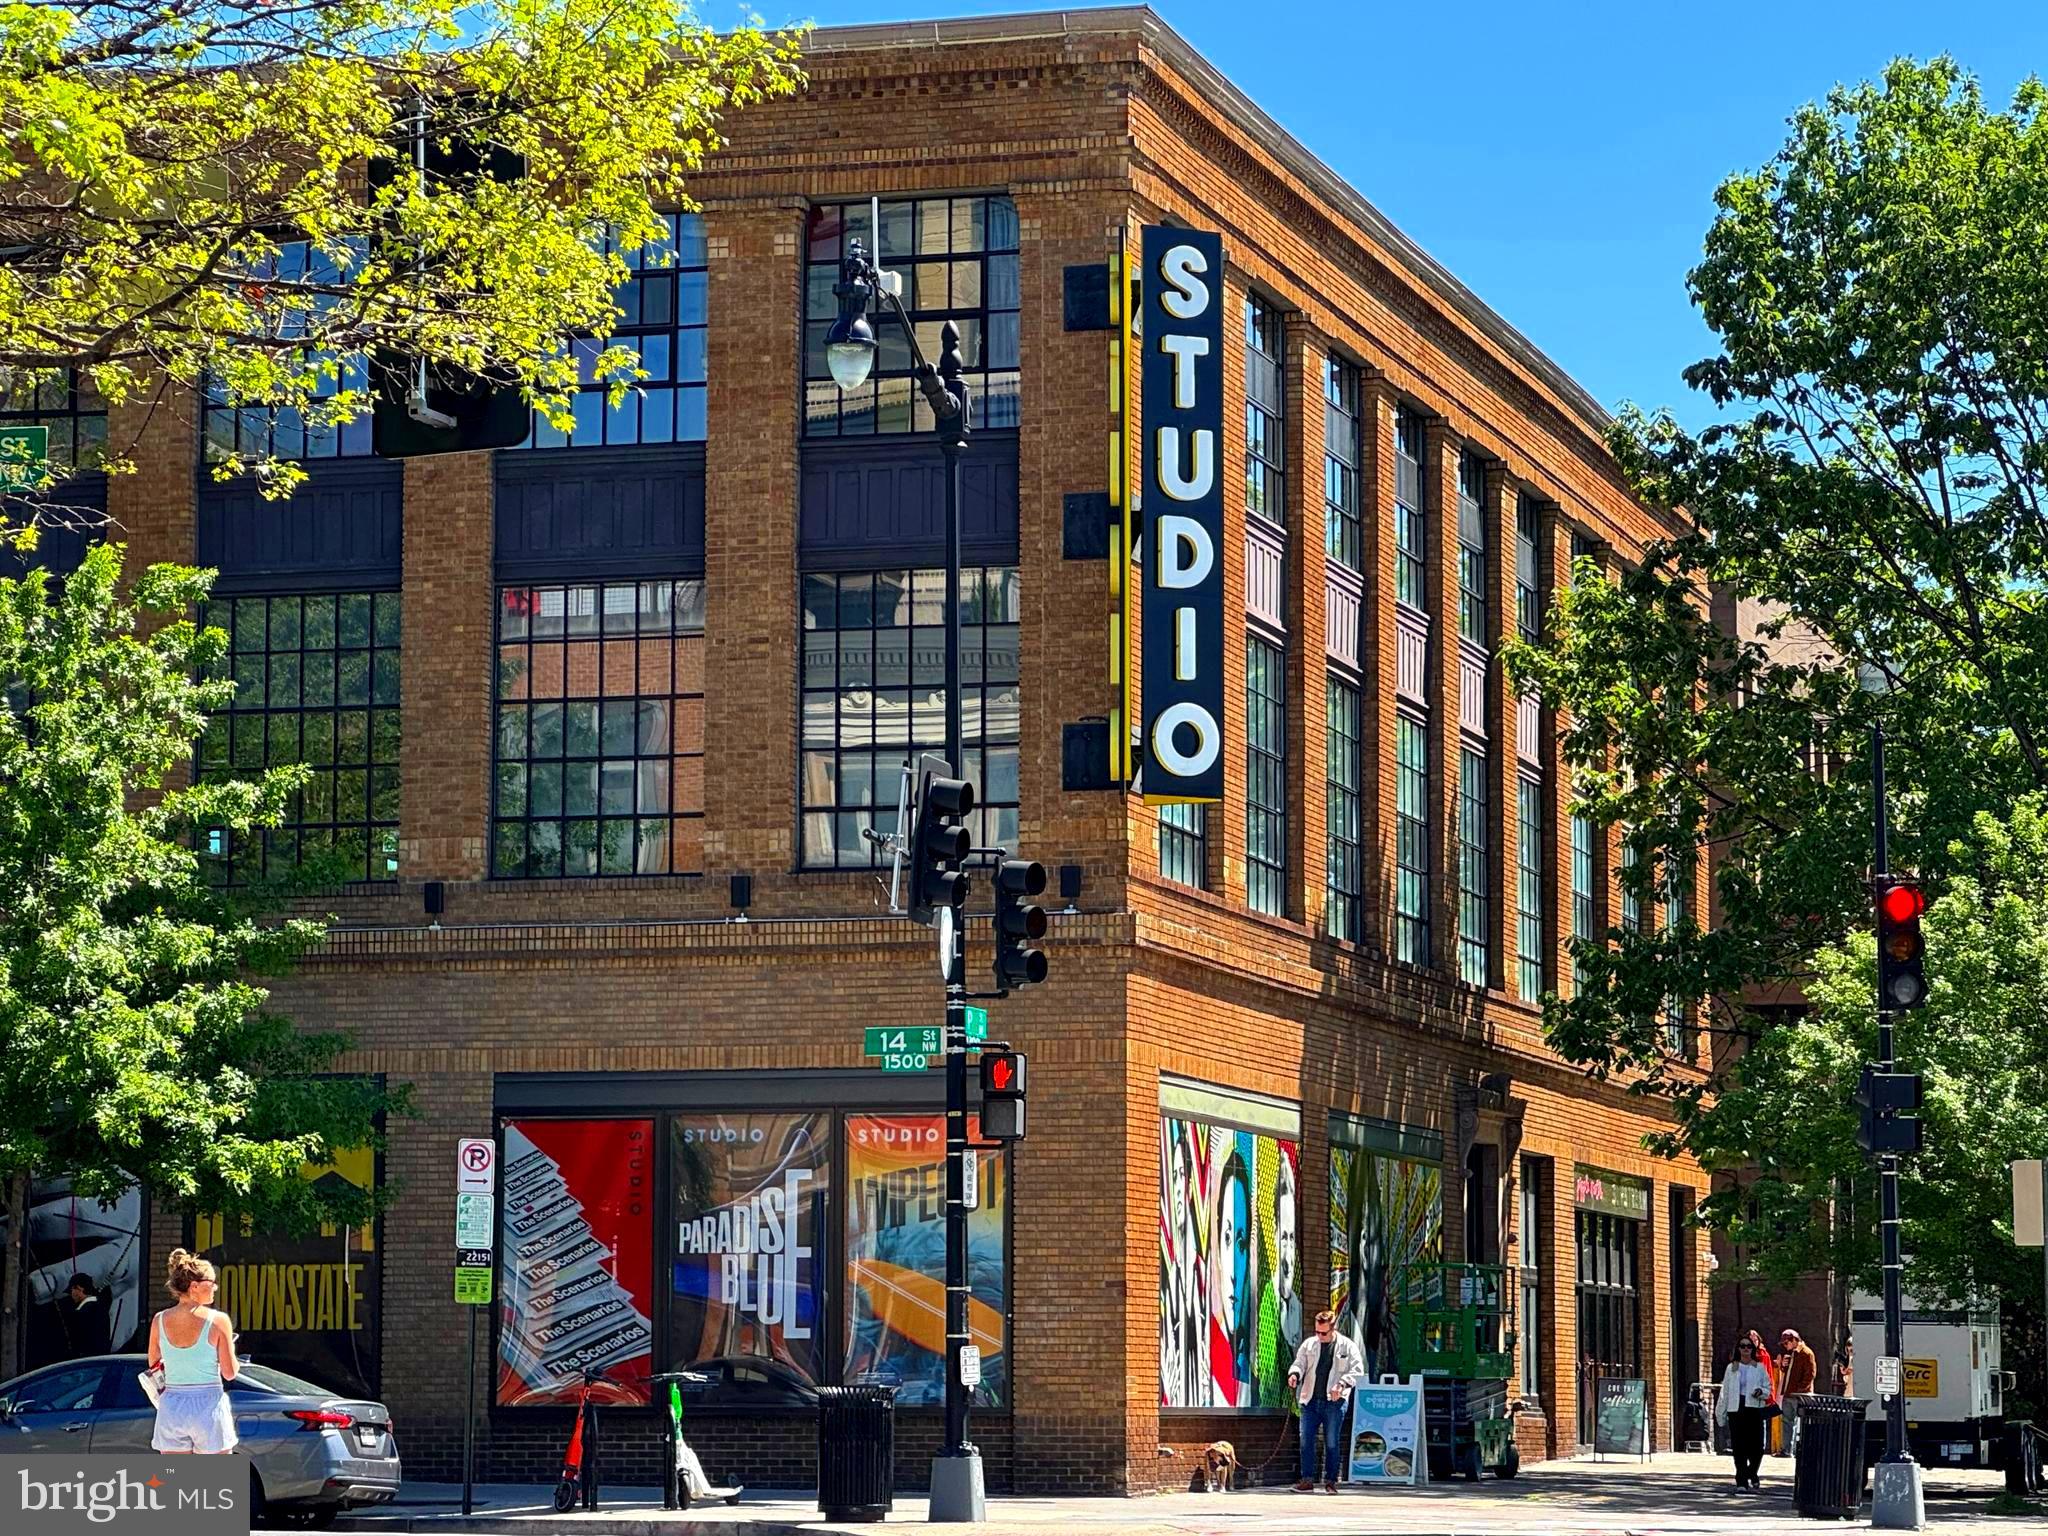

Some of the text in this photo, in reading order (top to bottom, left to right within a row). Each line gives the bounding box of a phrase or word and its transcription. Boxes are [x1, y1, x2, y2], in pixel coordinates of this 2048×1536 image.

[1152, 245, 1220, 777] STUDIO
[879, 1030, 936, 1052] 14 St
[922, 1041, 937, 1052] NW
[884, 1054, 926, 1069] 1500
[683, 1128, 764, 1143] STUDIO
[858, 1128, 940, 1143] STUDIO
[507, 1165, 551, 1190] The Scenarios
[629, 1131, 644, 1216] STUDIO
[510, 1181, 560, 1209] The Scenarios
[515, 1198, 576, 1230] The Scenarios
[679, 1168, 813, 1258] PARADISE
[521, 1221, 586, 1256] The Scenarios
[466, 1252, 490, 1262] 22151
[526, 1241, 599, 1281] The Scenarios
[214, 1263, 364, 1331] OWNSTATE
[530, 1273, 609, 1310] The Scenarios
[721, 1250, 812, 1339] BLUE
[535, 1300, 623, 1342] The Scenarios
[547, 1325, 645, 1375] The Scenarios
[1602, 1395, 1641, 1407] caffeine
